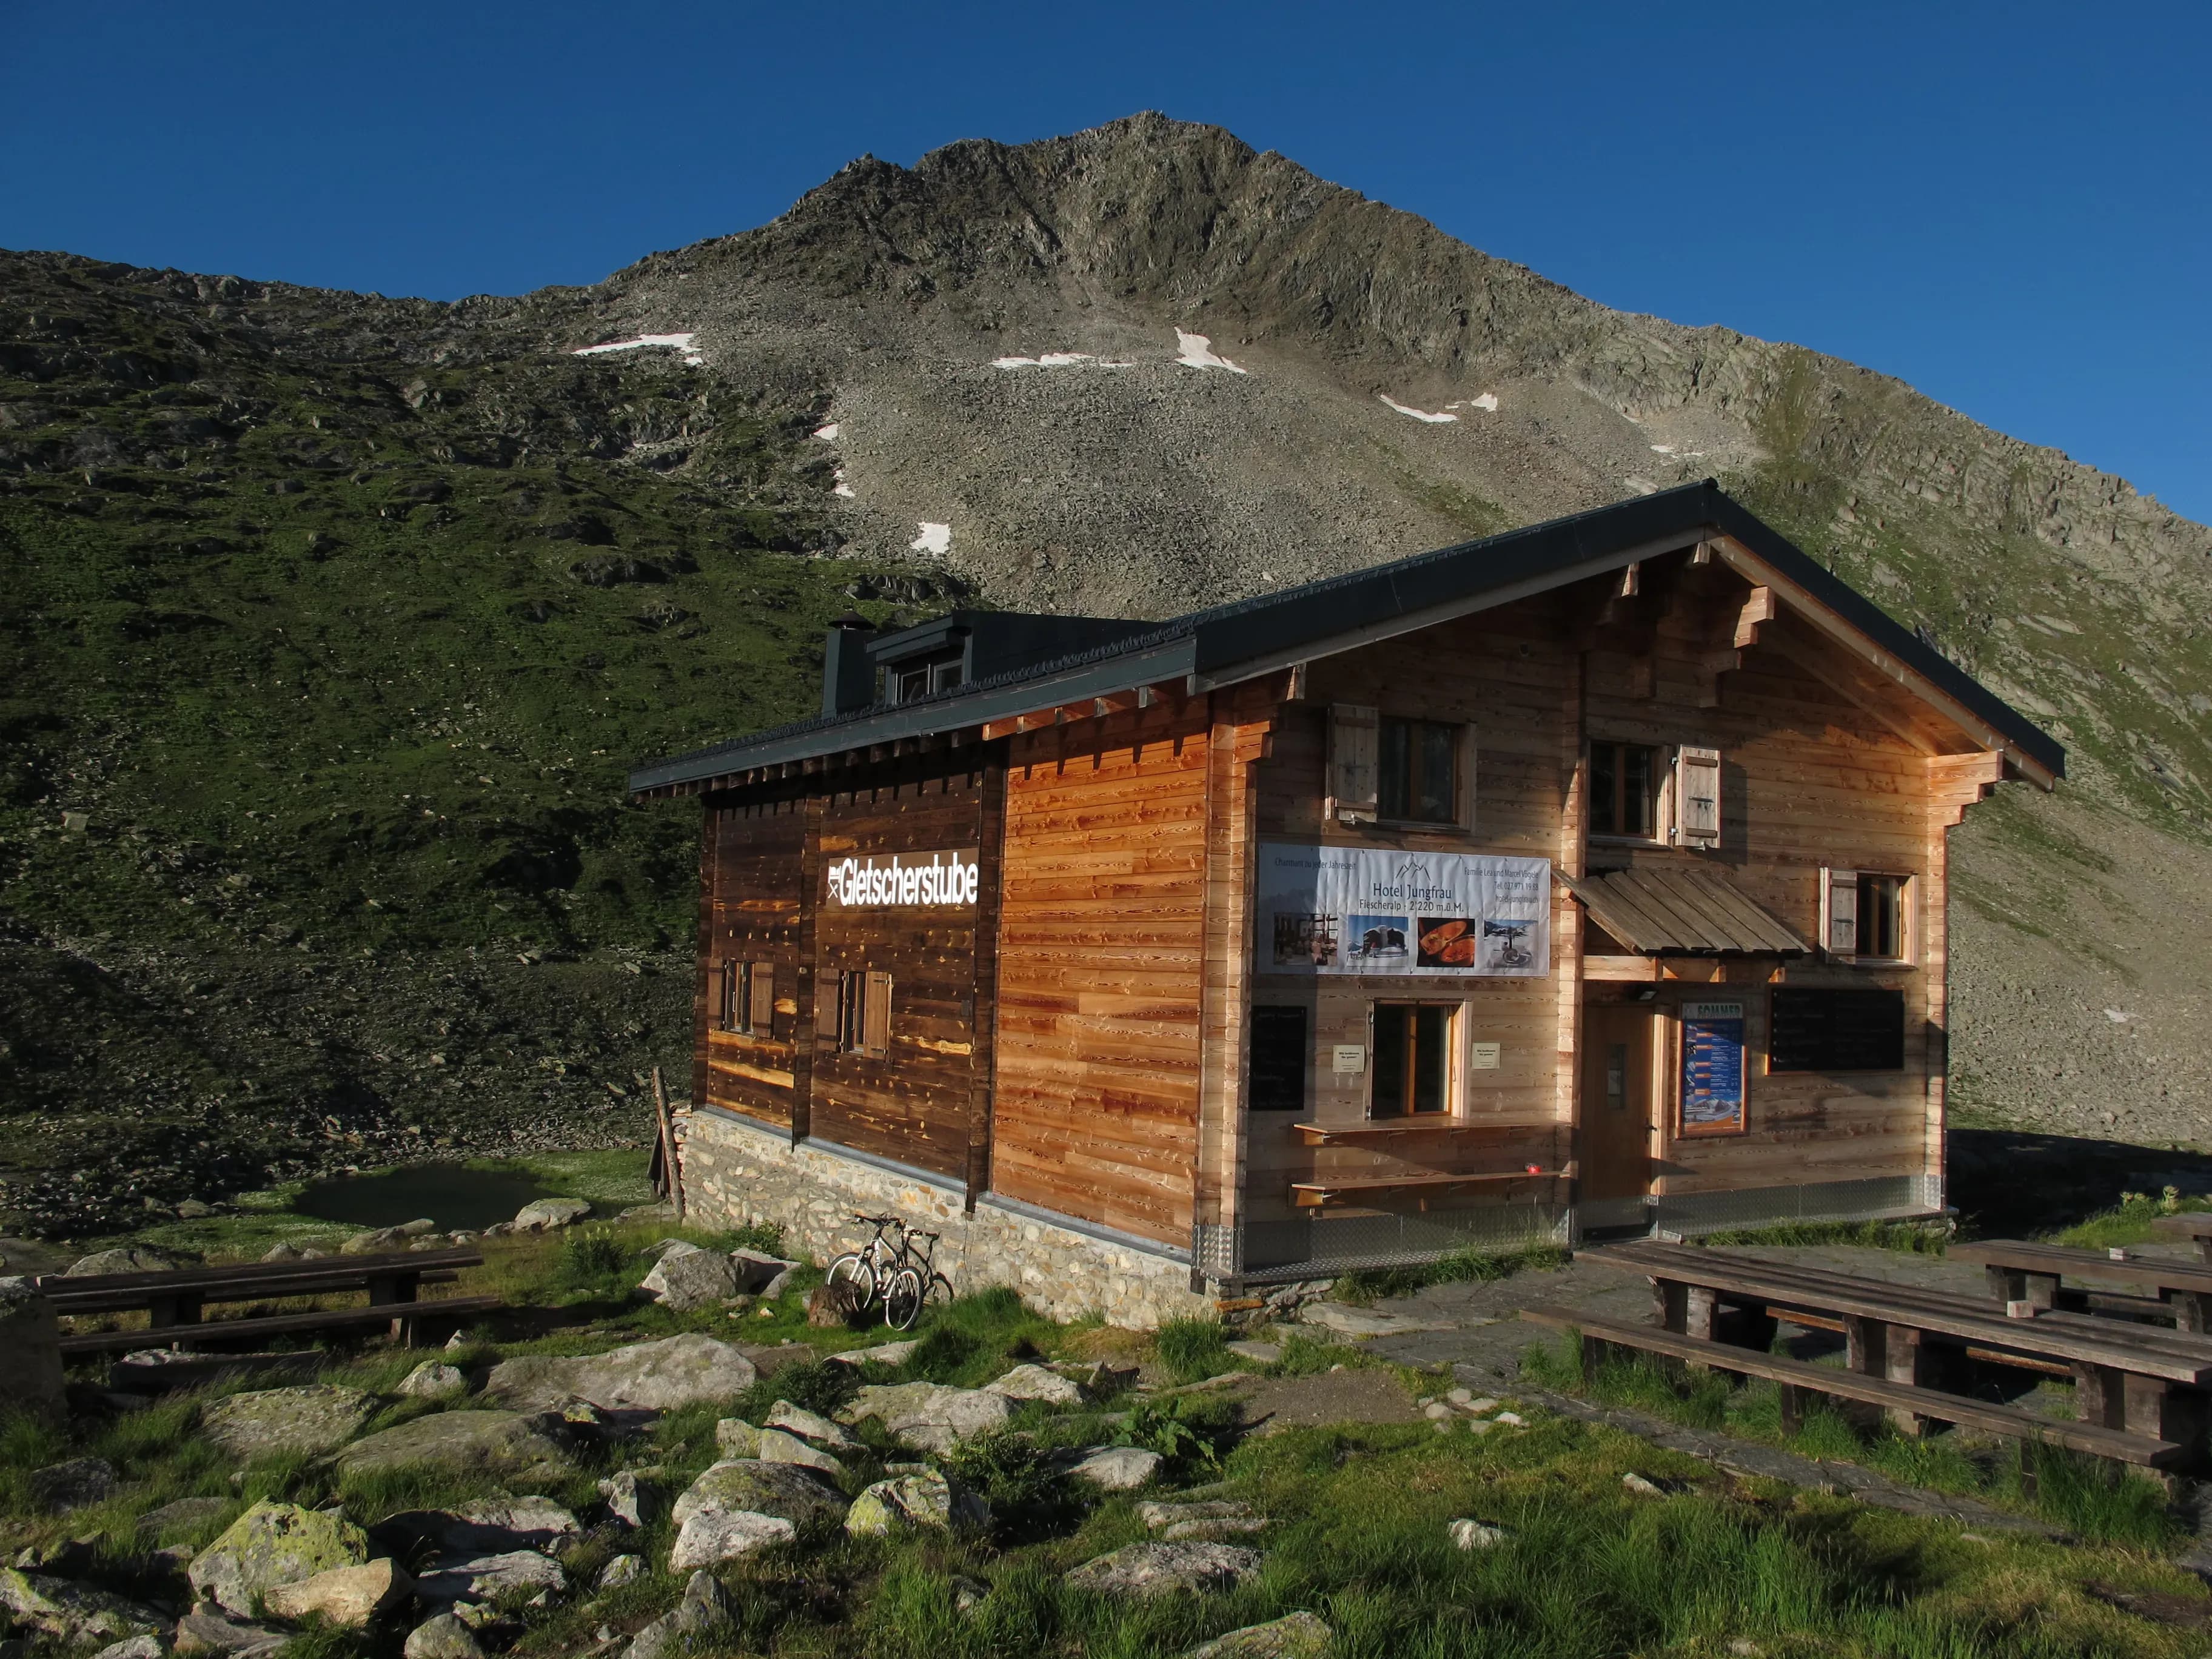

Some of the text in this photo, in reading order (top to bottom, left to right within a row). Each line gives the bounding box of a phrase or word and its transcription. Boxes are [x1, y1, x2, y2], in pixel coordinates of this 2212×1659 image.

[1275, 857, 1304, 868] Charmant
[1312, 860, 1327, 870] jeder
[1328, 860, 1356, 870] Jahreszeit
[1464, 867, 1483, 876] Familie
[1484, 868, 1493, 877] Lea
[1493, 869, 1504, 877] und
[1504, 870, 1521, 878] Marcel
[840, 851, 979, 907] Gletscherstube
[1373, 883, 1452, 901] Hotel Jungfrau
[1504, 882, 1513, 890] 027
[1513, 882, 1524, 891] 971
[1359, 899, 1402, 911] Fiescheralp
[1409, 901, 1434, 911] 2'220
